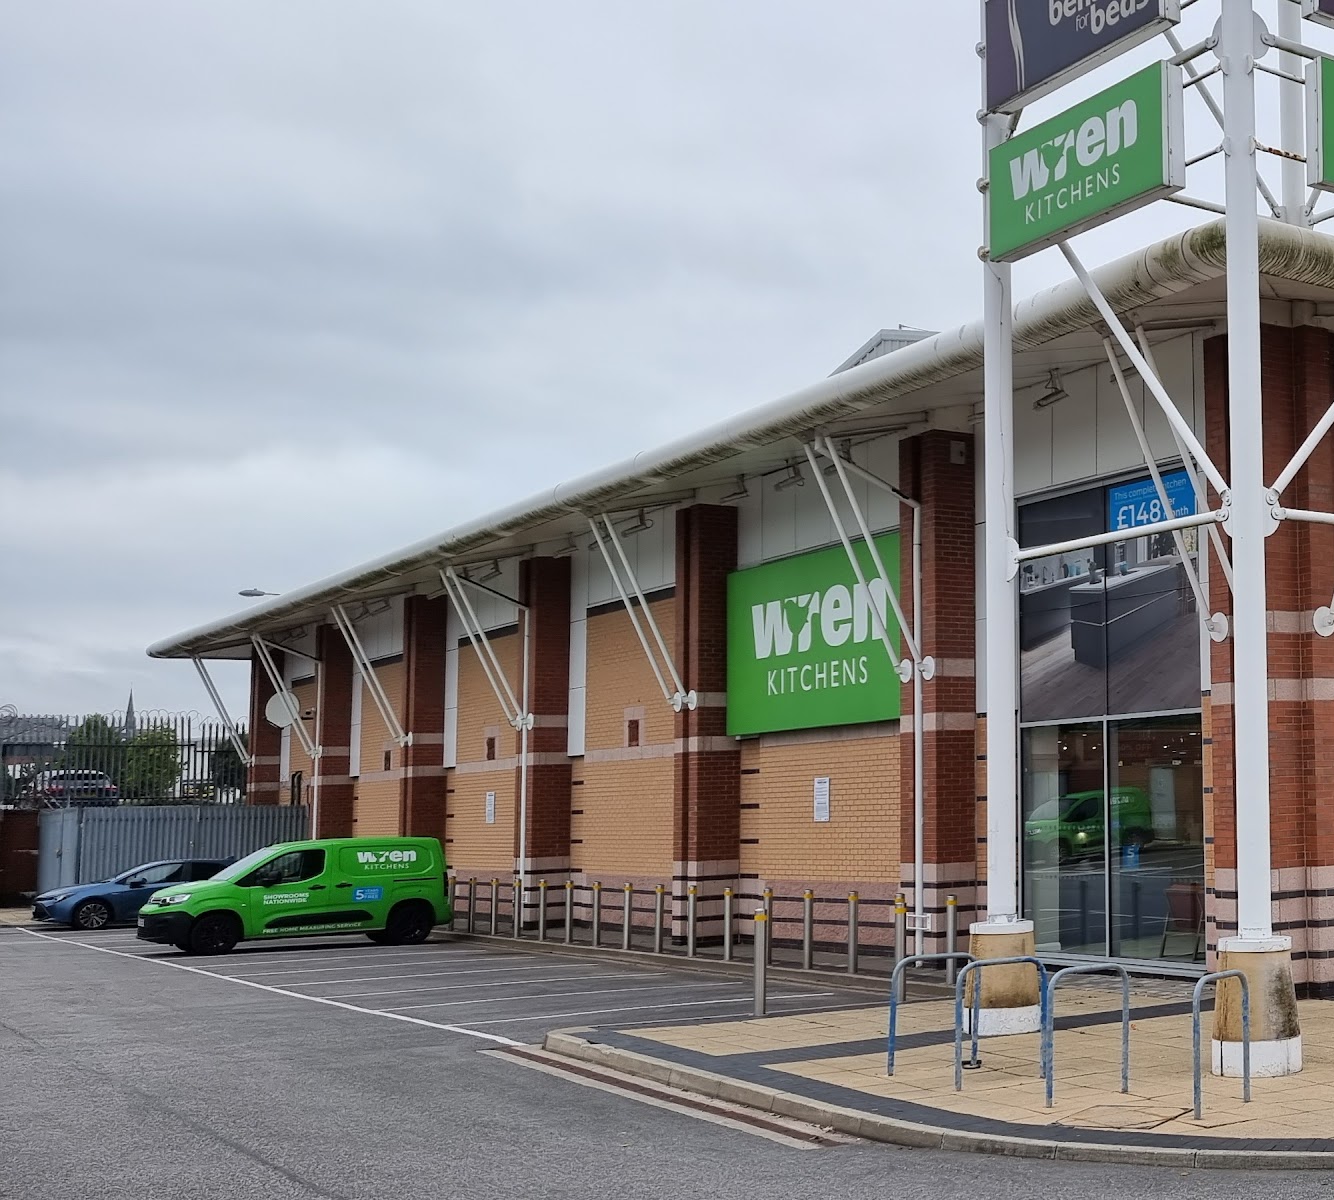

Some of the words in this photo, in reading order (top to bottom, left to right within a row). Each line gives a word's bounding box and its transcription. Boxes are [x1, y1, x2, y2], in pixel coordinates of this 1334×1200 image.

[1075, 13, 1090, 31] for
[1009, 98, 1138, 201] wren
[1025, 162, 1120, 225] KITCHENS
[1114, 493, 1127, 501] This
[1128, 485, 1156, 499] complet
[1163, 478, 1187, 489] itchen
[1117, 499, 1161, 530] £148
[752, 578, 889, 660] wren
[767, 656, 868, 696] KITCHENS
[357, 850, 416, 863] wren
[264, 892, 309, 900] SHOWROOMS
[356, 889, 364, 900] 5
[300, 923, 336, 931] MEASURING
